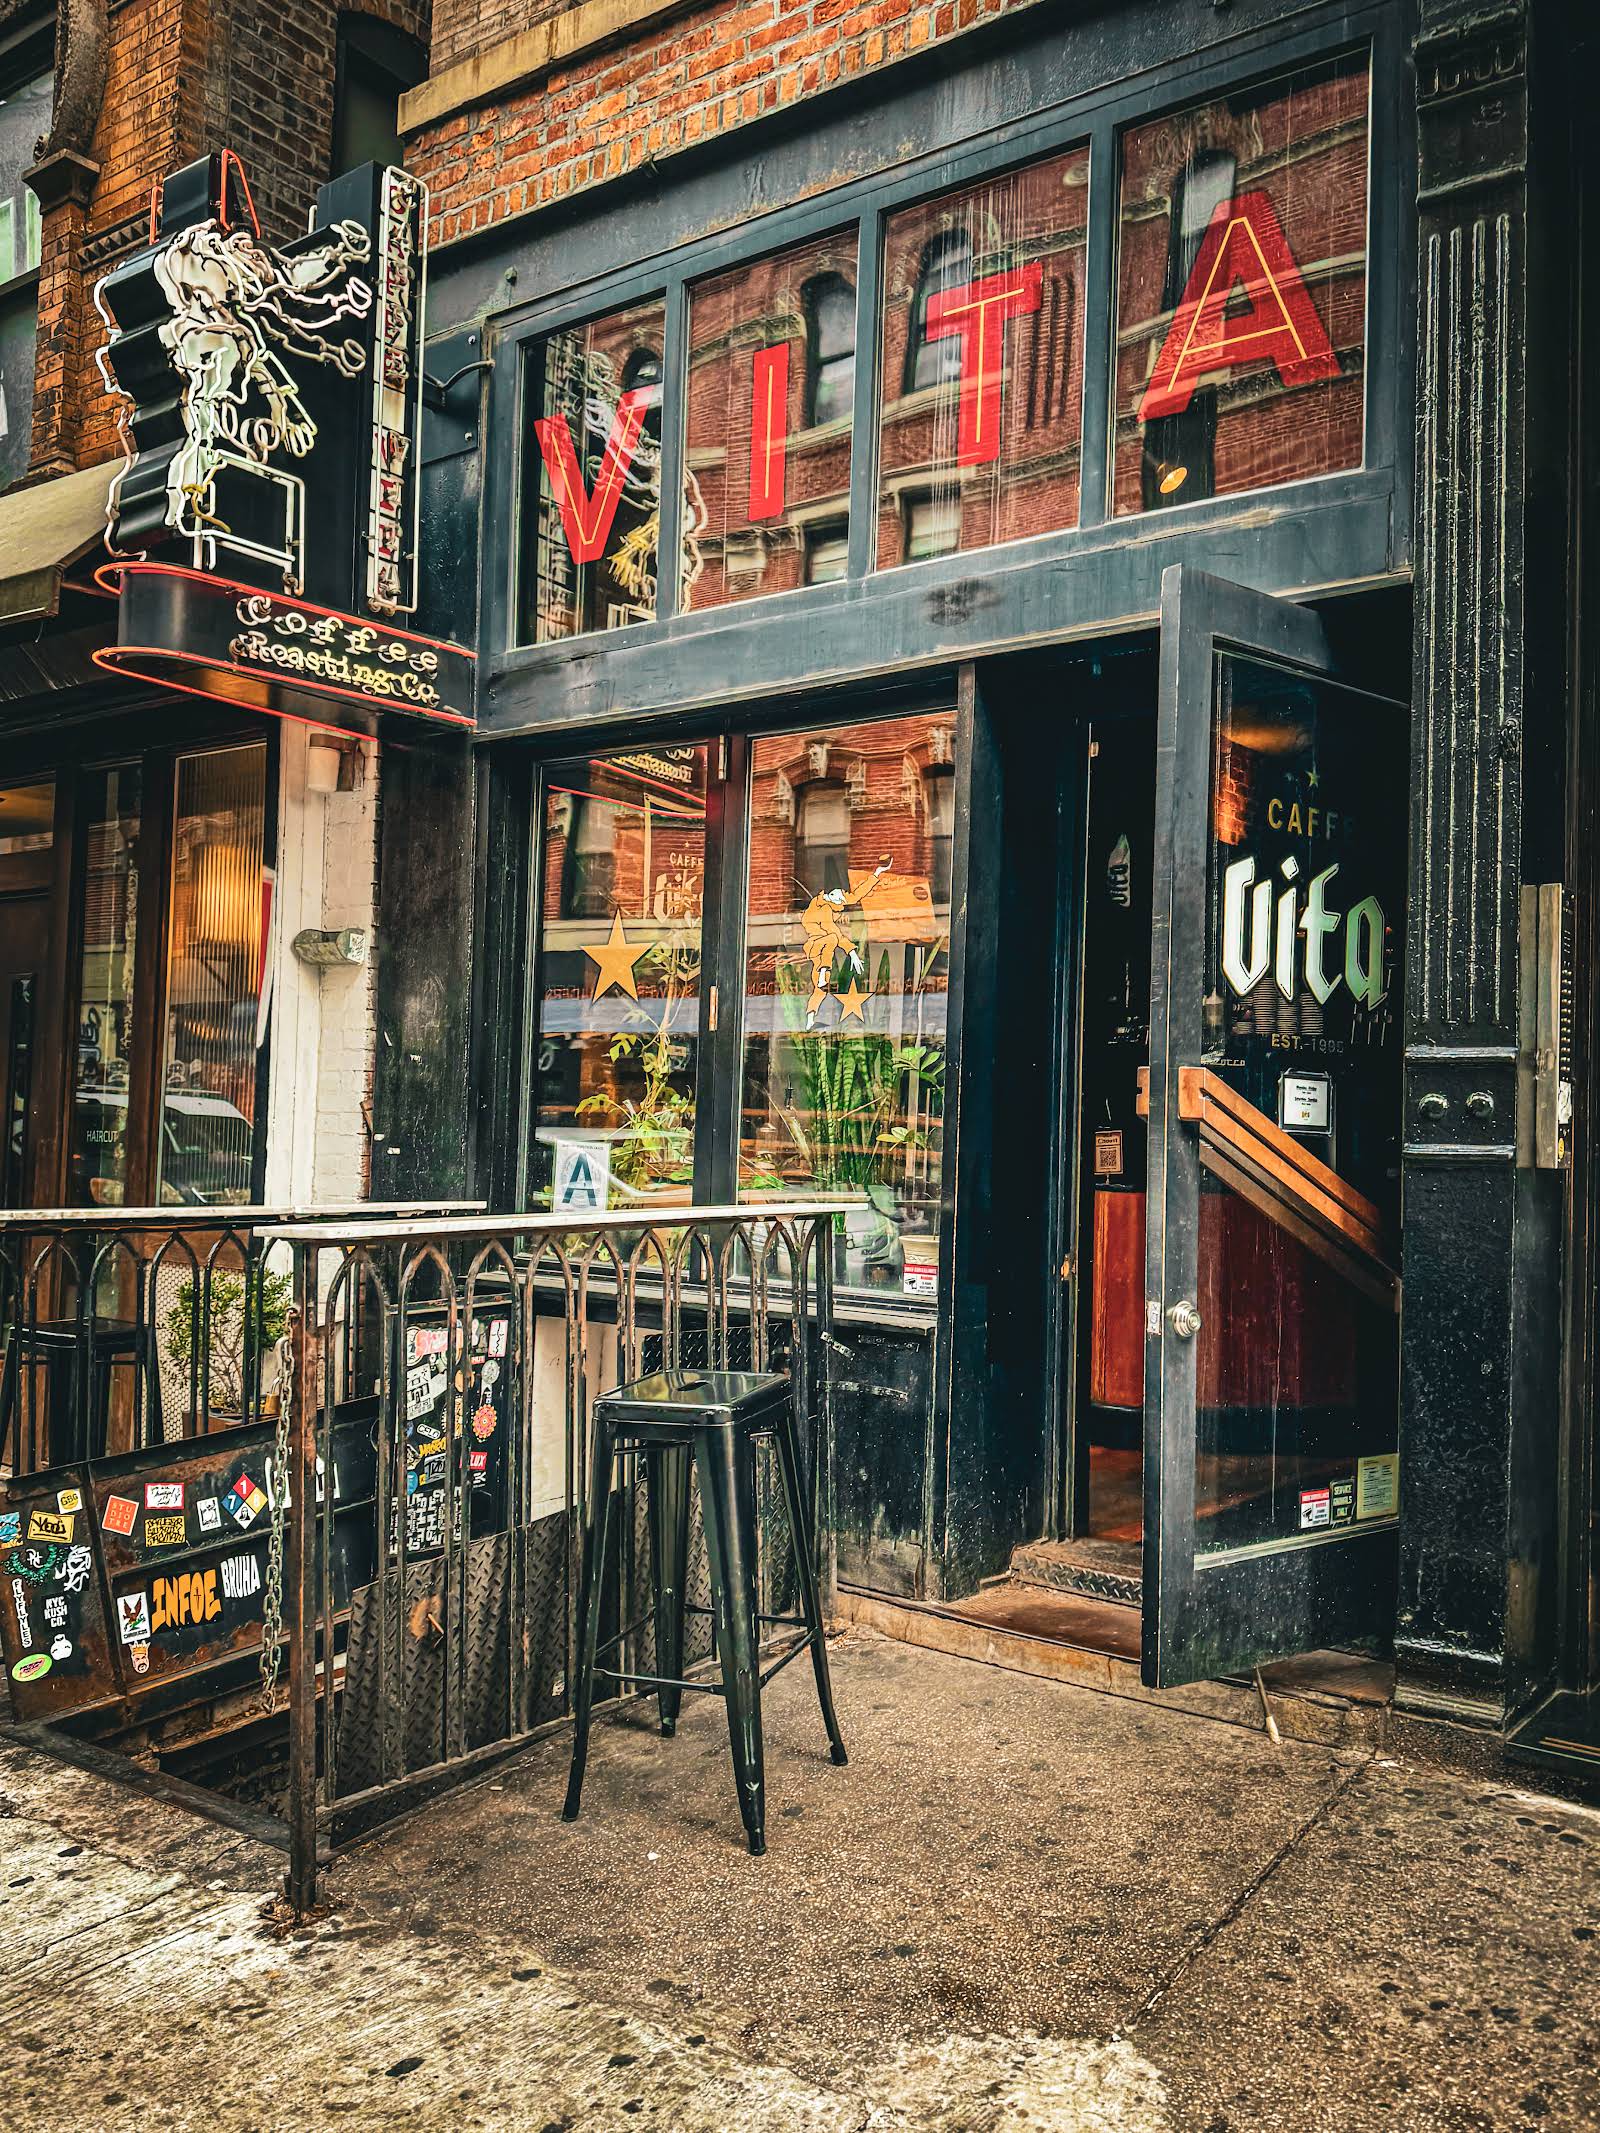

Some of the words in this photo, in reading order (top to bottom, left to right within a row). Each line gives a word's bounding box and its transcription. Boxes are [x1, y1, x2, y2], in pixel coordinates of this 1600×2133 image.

[534, 190, 1341, 564] VITA
[235, 595, 438, 680] Coffee
[229, 630, 400, 696] Roasting
[1267, 798, 1352, 841] CAFF
[653, 873, 704, 928] Vit
[1221, 854, 1388, 1013] Vita
[561, 1152, 597, 1207] A
[111, 1502, 132, 1513] STU
[228, 1494, 237, 1510] 7
[240, 1479, 247, 1495] 1
[108, 1518, 128, 1529] TRE
[110, 1510, 130, 1521] DIO
[220, 1554, 261, 1598] BRUHA
[44, 1606, 68, 1620] KUSH
[45, 1596, 65, 1610] NYC
[152, 1568, 222, 1634] INFOE
